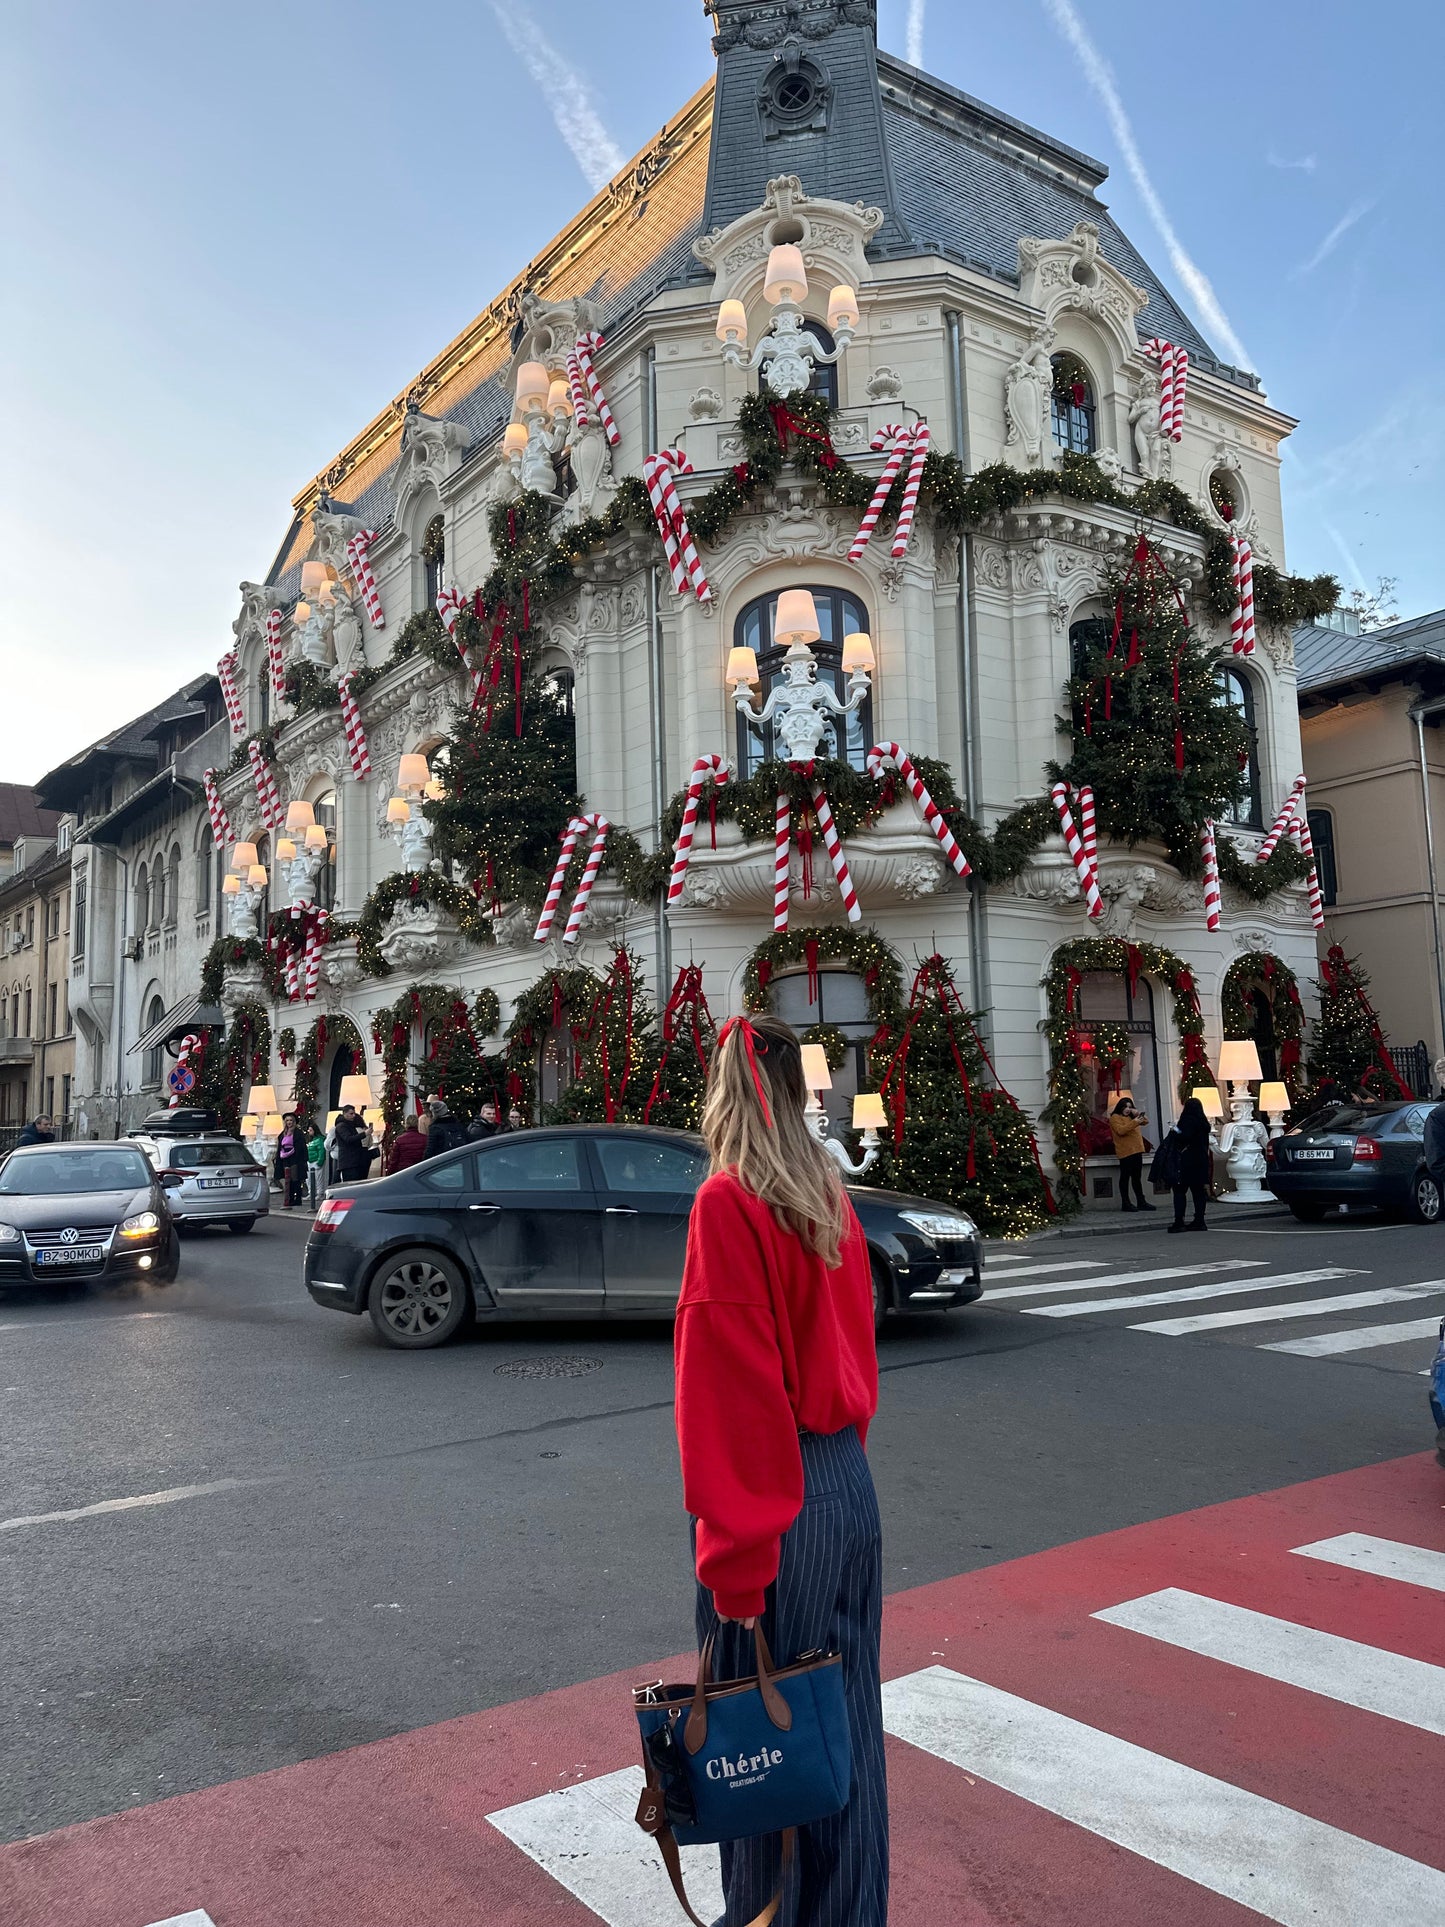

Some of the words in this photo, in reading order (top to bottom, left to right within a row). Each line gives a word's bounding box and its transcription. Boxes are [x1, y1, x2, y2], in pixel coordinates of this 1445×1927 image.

[1299, 1150, 1305, 1158] B
[1306, 1150, 1315, 1158] 65
[1316, 1150, 1330, 1158] MYA
[61, 1228, 78, 1243] VW
[43, 1251, 60, 1262] BZ
[706, 1746, 784, 1780] Chérie
[644, 1805, 657, 1822] B
